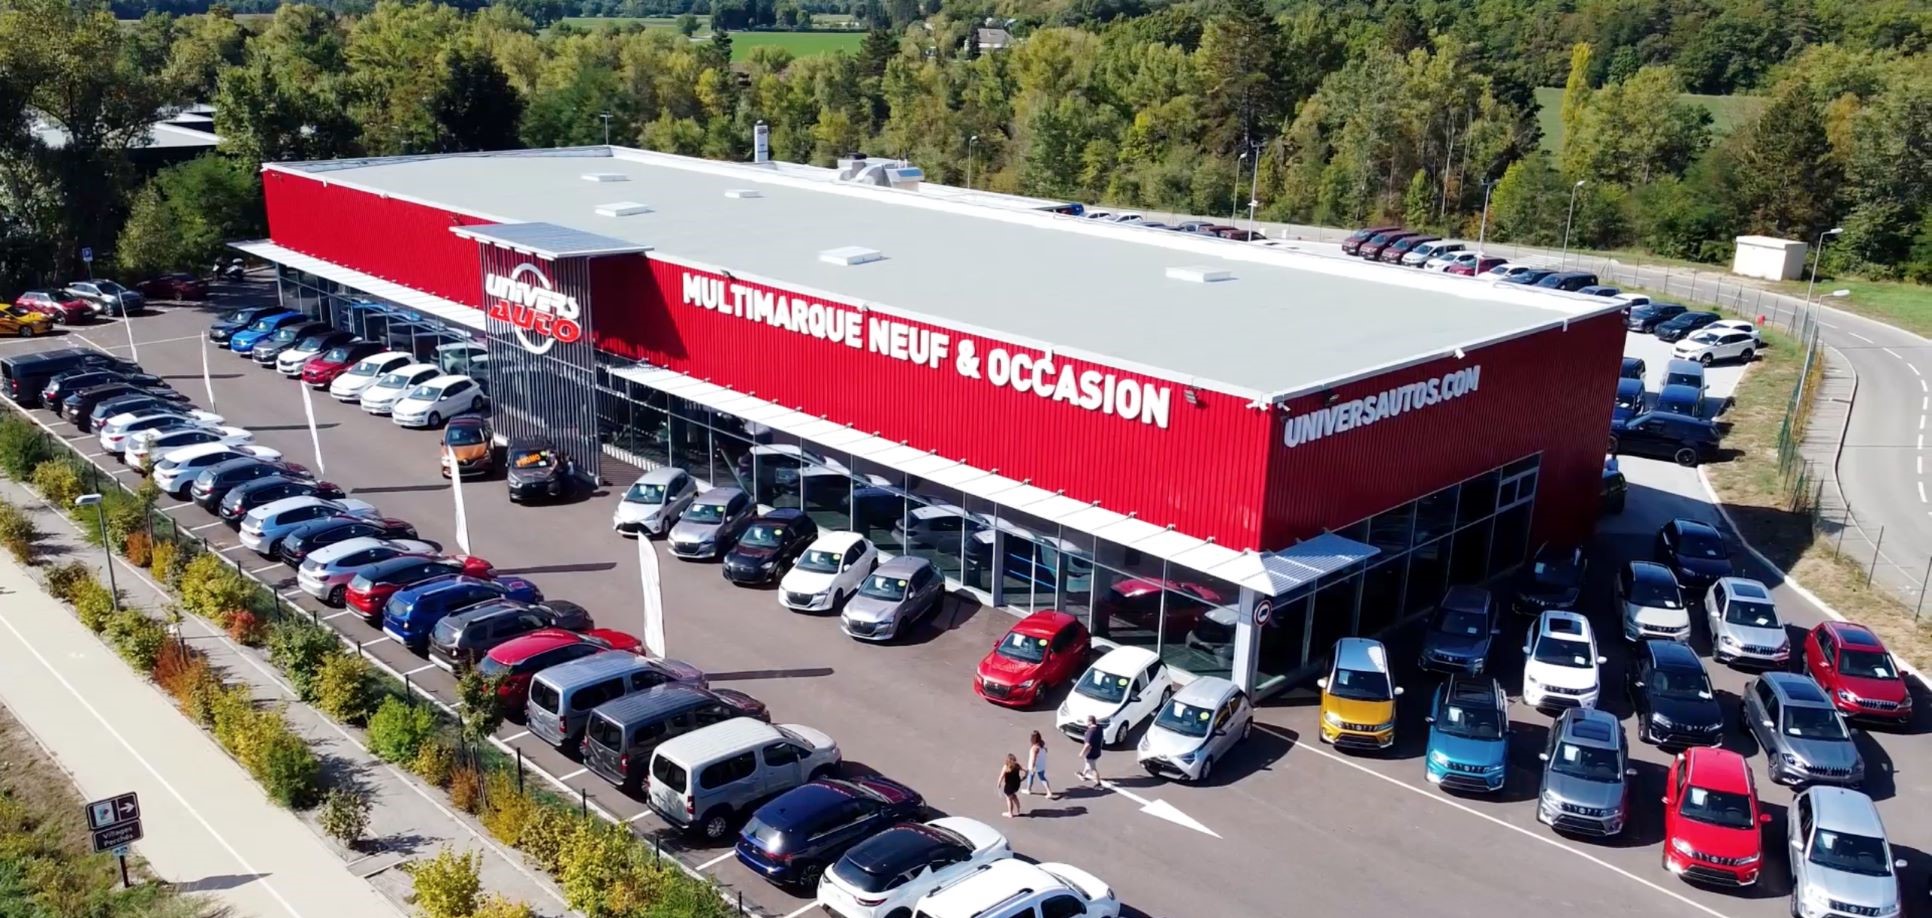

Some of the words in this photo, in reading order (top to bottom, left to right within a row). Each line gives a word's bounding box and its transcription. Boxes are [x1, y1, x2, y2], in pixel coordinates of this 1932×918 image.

[485, 273, 579, 320] UNIVERS
[487, 299, 581, 343] AUTO
[682, 272, 863, 349] MULTIMARQUE
[868, 317, 950, 369] NEUF
[956, 339, 982, 379] &
[987, 348, 1171, 429] OCCASION
[1284, 365, 1481, 448] UNIVERSAUTOS.COM
[102, 827, 133, 839] Villages
